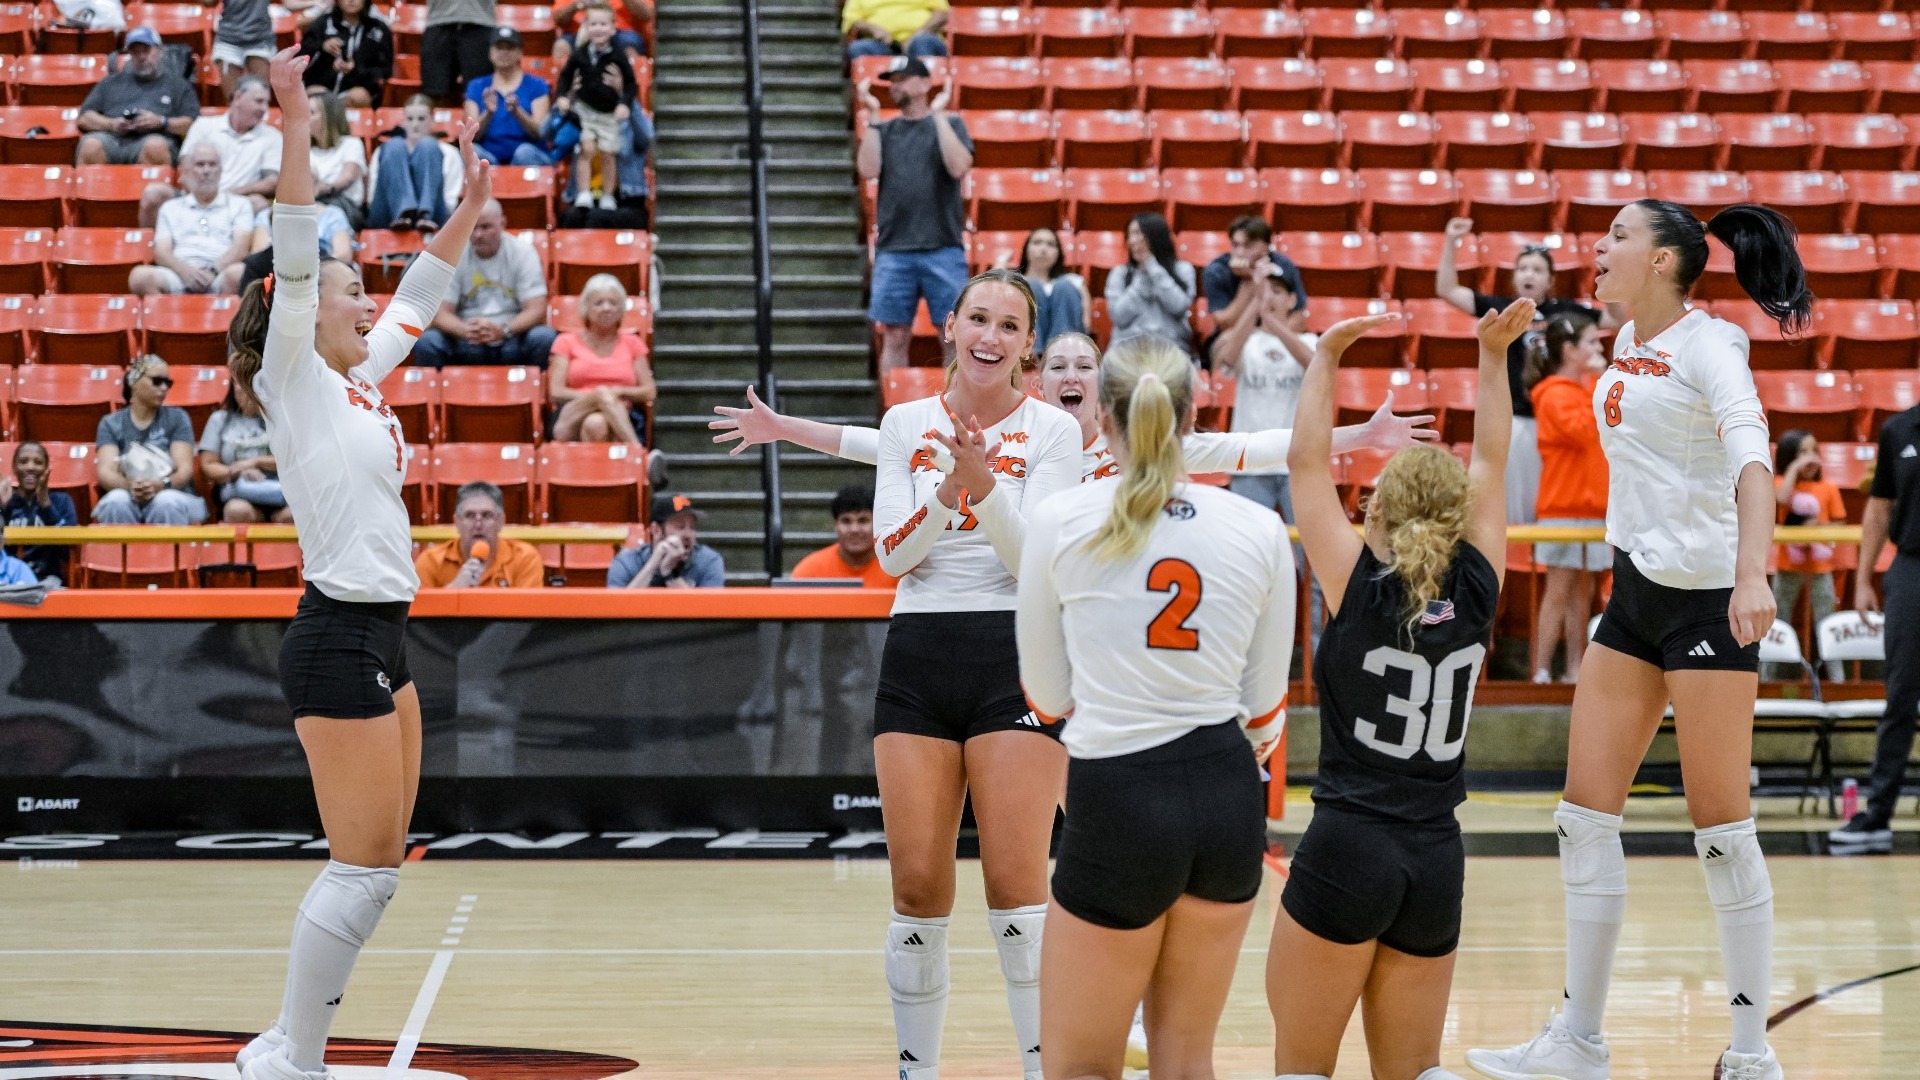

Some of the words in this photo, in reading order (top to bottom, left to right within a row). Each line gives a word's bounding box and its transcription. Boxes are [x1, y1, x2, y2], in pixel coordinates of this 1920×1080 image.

[1604, 381, 1624, 427] 8
[389, 424, 402, 472] 1
[1146, 557, 1203, 651] 2
[1353, 641, 1487, 762] 30
[35, 797, 80, 810] ADART
[850, 795, 881, 808] ADA
